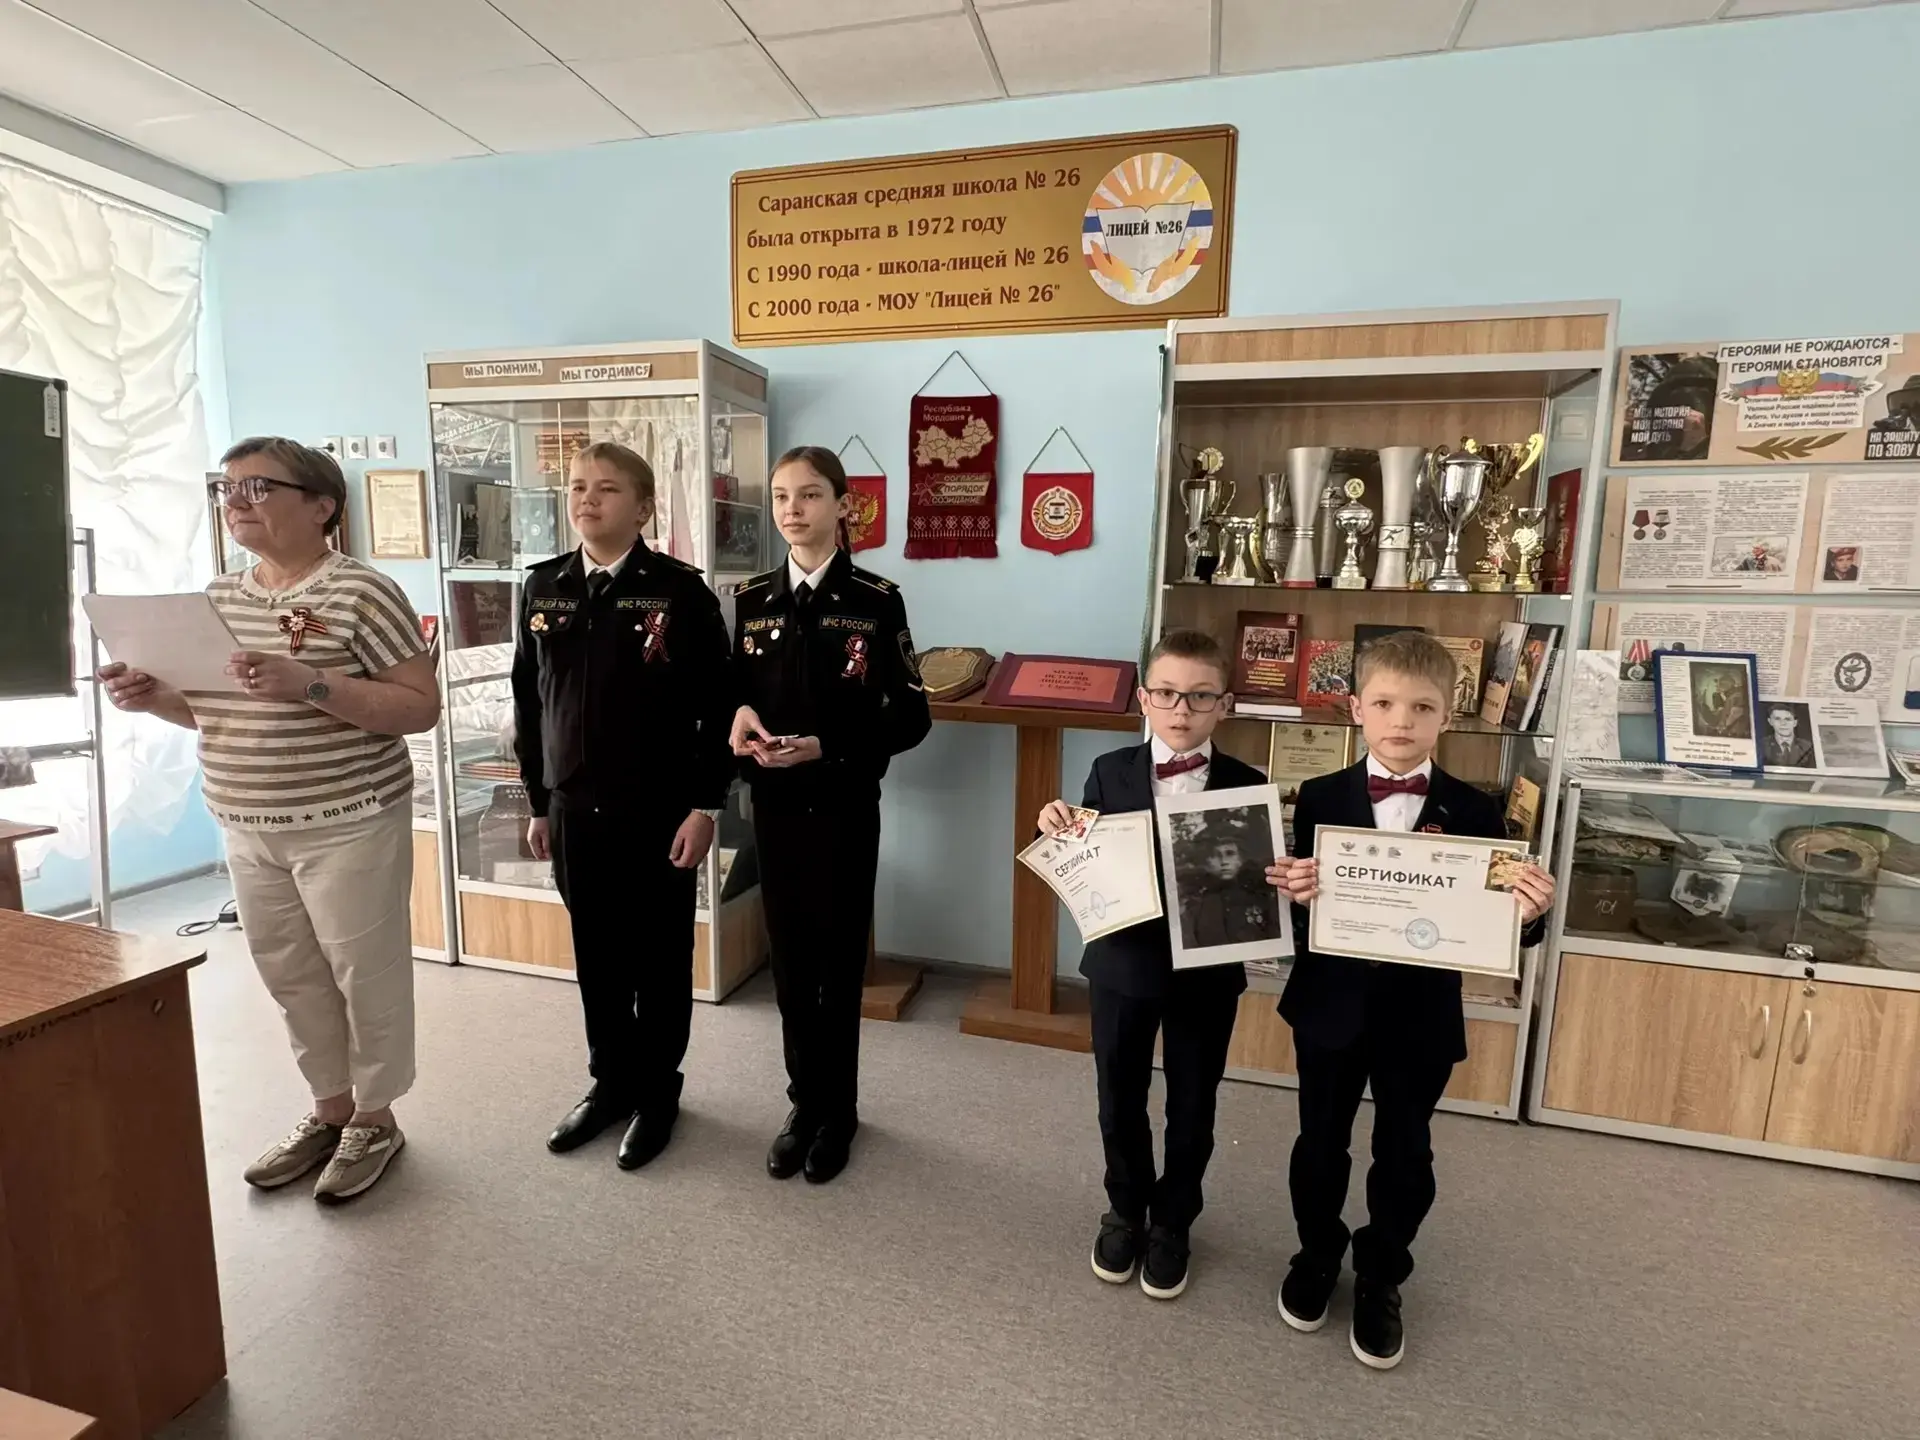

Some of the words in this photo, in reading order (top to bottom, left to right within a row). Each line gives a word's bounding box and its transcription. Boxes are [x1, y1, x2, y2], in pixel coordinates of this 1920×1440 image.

[758, 192, 858, 216] Саранская
[864, 184, 945, 208] средняя
[952, 176, 1018, 196] школа
[1025, 170, 1046, 190] №
[1054, 167, 1081, 188] 26
[746, 229, 794, 248] была
[800, 226, 880, 246] открыта
[887, 224, 898, 238] в
[908, 216, 954, 236] 1972
[962, 215, 1008, 236] году
[1106, 218, 1150, 237] ЛИЦЕЙ
[1155, 220, 1183, 234] №26
[747, 266, 760, 284] С
[768, 264, 812, 282] 1990
[818, 263, 860, 281] года
[878, 250, 1008, 276] школа-лицей
[1014, 248, 1036, 266] №
[1043, 245, 1070, 265] 26
[748, 301, 760, 318] С
[766, 298, 812, 317] 2000
[818, 298, 860, 317] года
[878, 292, 920, 311] МОУ
[925, 288, 993, 309] "Лицей
[1000, 286, 1020, 304] №
[1028, 284, 1060, 304] 26"
[1720, 344, 1782, 358] ГЕРОЯМИ
[1784, 342, 1802, 354] НЕ
[1805, 338, 1890, 352] РОЖДАЮТСЯ
[464, 366, 484, 376] МЫ
[486, 363, 542, 376] ПОМНИМ,
[1732, 360, 1793, 374] ГЕРОЯМИ
[1796, 355, 1883, 370] СТАНОВЯТСЯ
[561, 370, 582, 381] МЫ
[584, 365, 651, 380] ГОРДИМСЯ
[922, 404, 972, 414] Республика
[1654, 405, 1691, 418] ИСТОРИЯ
[922, 414, 966, 422] Мордовия
[1632, 418, 1651, 430] МОЯ
[1652, 418, 1684, 430] СТРАНА
[1630, 431, 1650, 443] МОЙ
[1870, 432, 1882, 443] НА
[1883, 431, 1920, 443] ЗАЩИТУ
[1868, 444, 1884, 458] ПО
[1885, 442, 1916, 457] ЗОВУ
[944, 484, 985, 494] ПОРЯДОК
[532, 599, 556, 609] ЛИЦЕЙ
[566, 600, 576, 609] 26
[616, 600, 634, 608] МЧС
[635, 600, 668, 609] РОССИИ
[822, 617, 840, 628] МЧС
[840, 618, 874, 632] РОССИИ
[322, 808, 340, 819] DO
[342, 801, 364, 814] NOT
[229, 813, 240, 822] DO
[243, 815, 261, 824] NOT
[264, 815, 294, 824] PASS
[1335, 865, 1457, 888] СЕРТИФИКАТ
